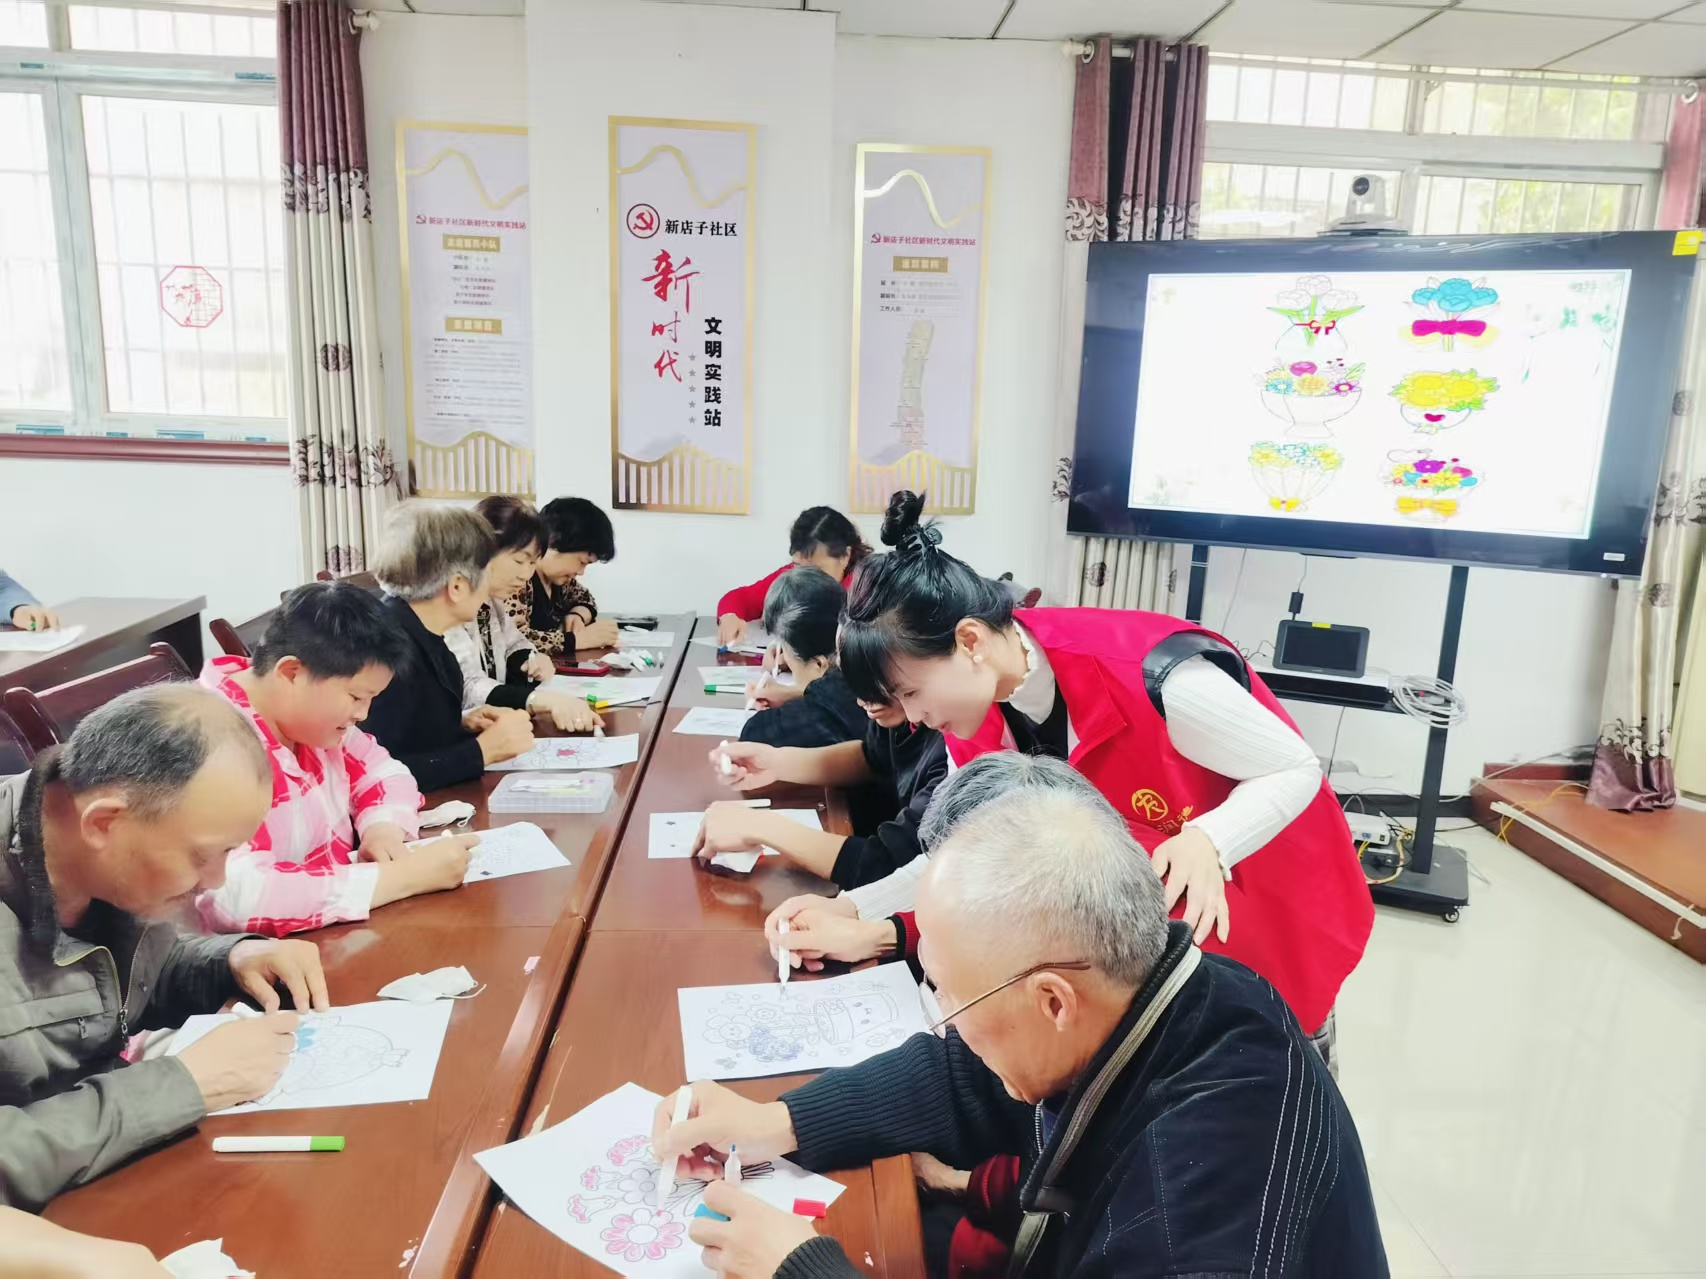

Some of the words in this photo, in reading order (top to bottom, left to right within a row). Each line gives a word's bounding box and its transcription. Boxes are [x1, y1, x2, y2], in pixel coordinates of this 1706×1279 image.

[664, 218, 738, 236] 新店子社区
[704, 316, 722, 427] 文明实践站
